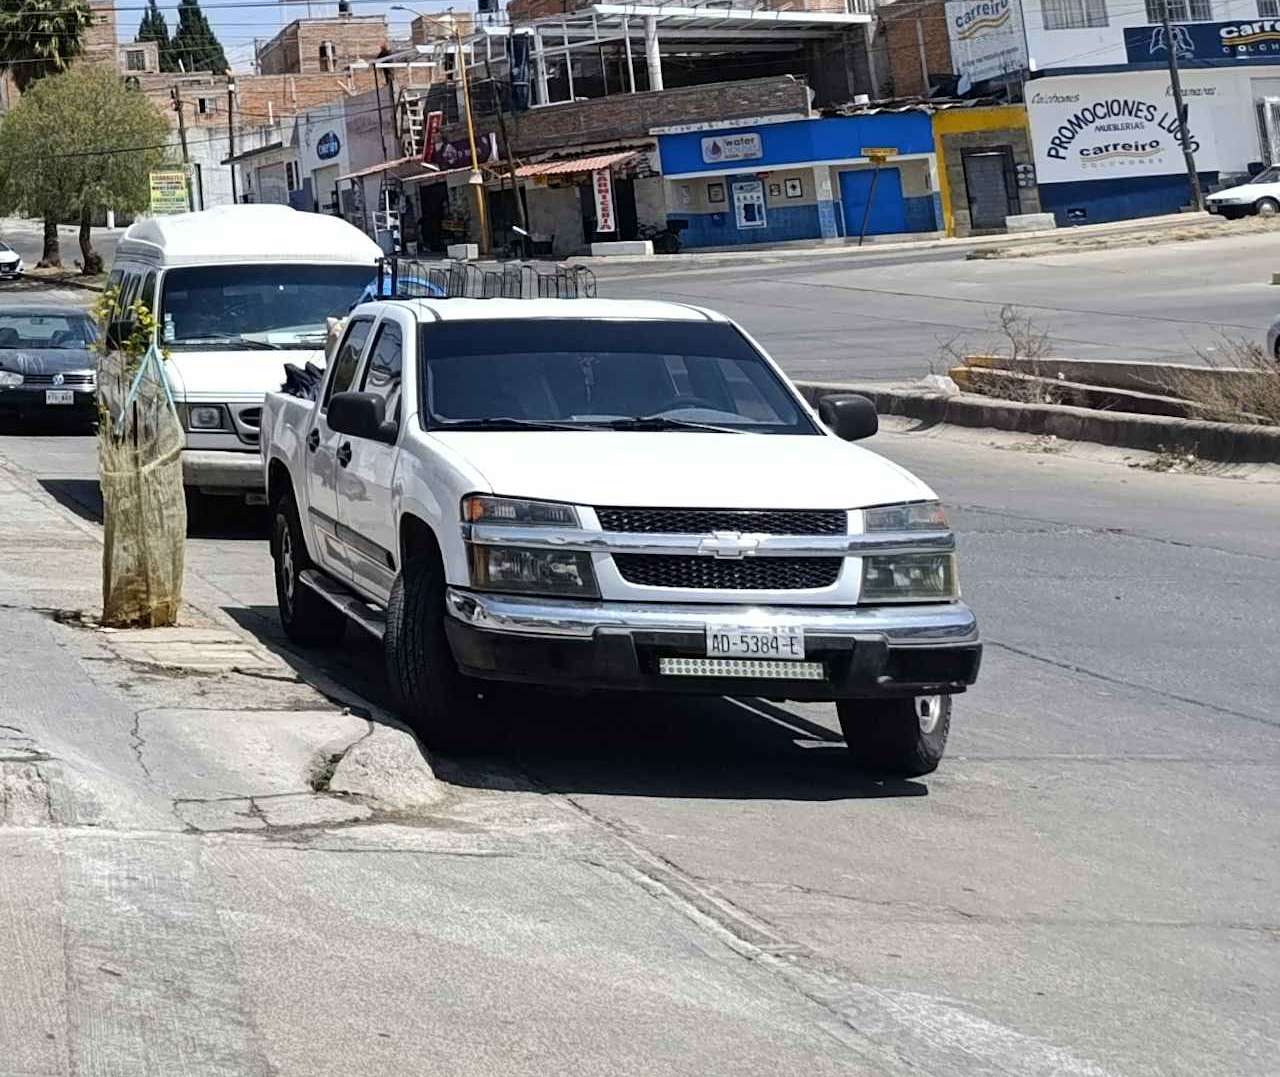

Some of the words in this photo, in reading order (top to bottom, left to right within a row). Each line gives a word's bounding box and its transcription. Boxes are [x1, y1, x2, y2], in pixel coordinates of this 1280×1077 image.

[1047, 99, 1157, 160] PROMOCIONES
[1079, 139, 1160, 157] carreiro
[711, 634, 799, 655] AD-5384-E
